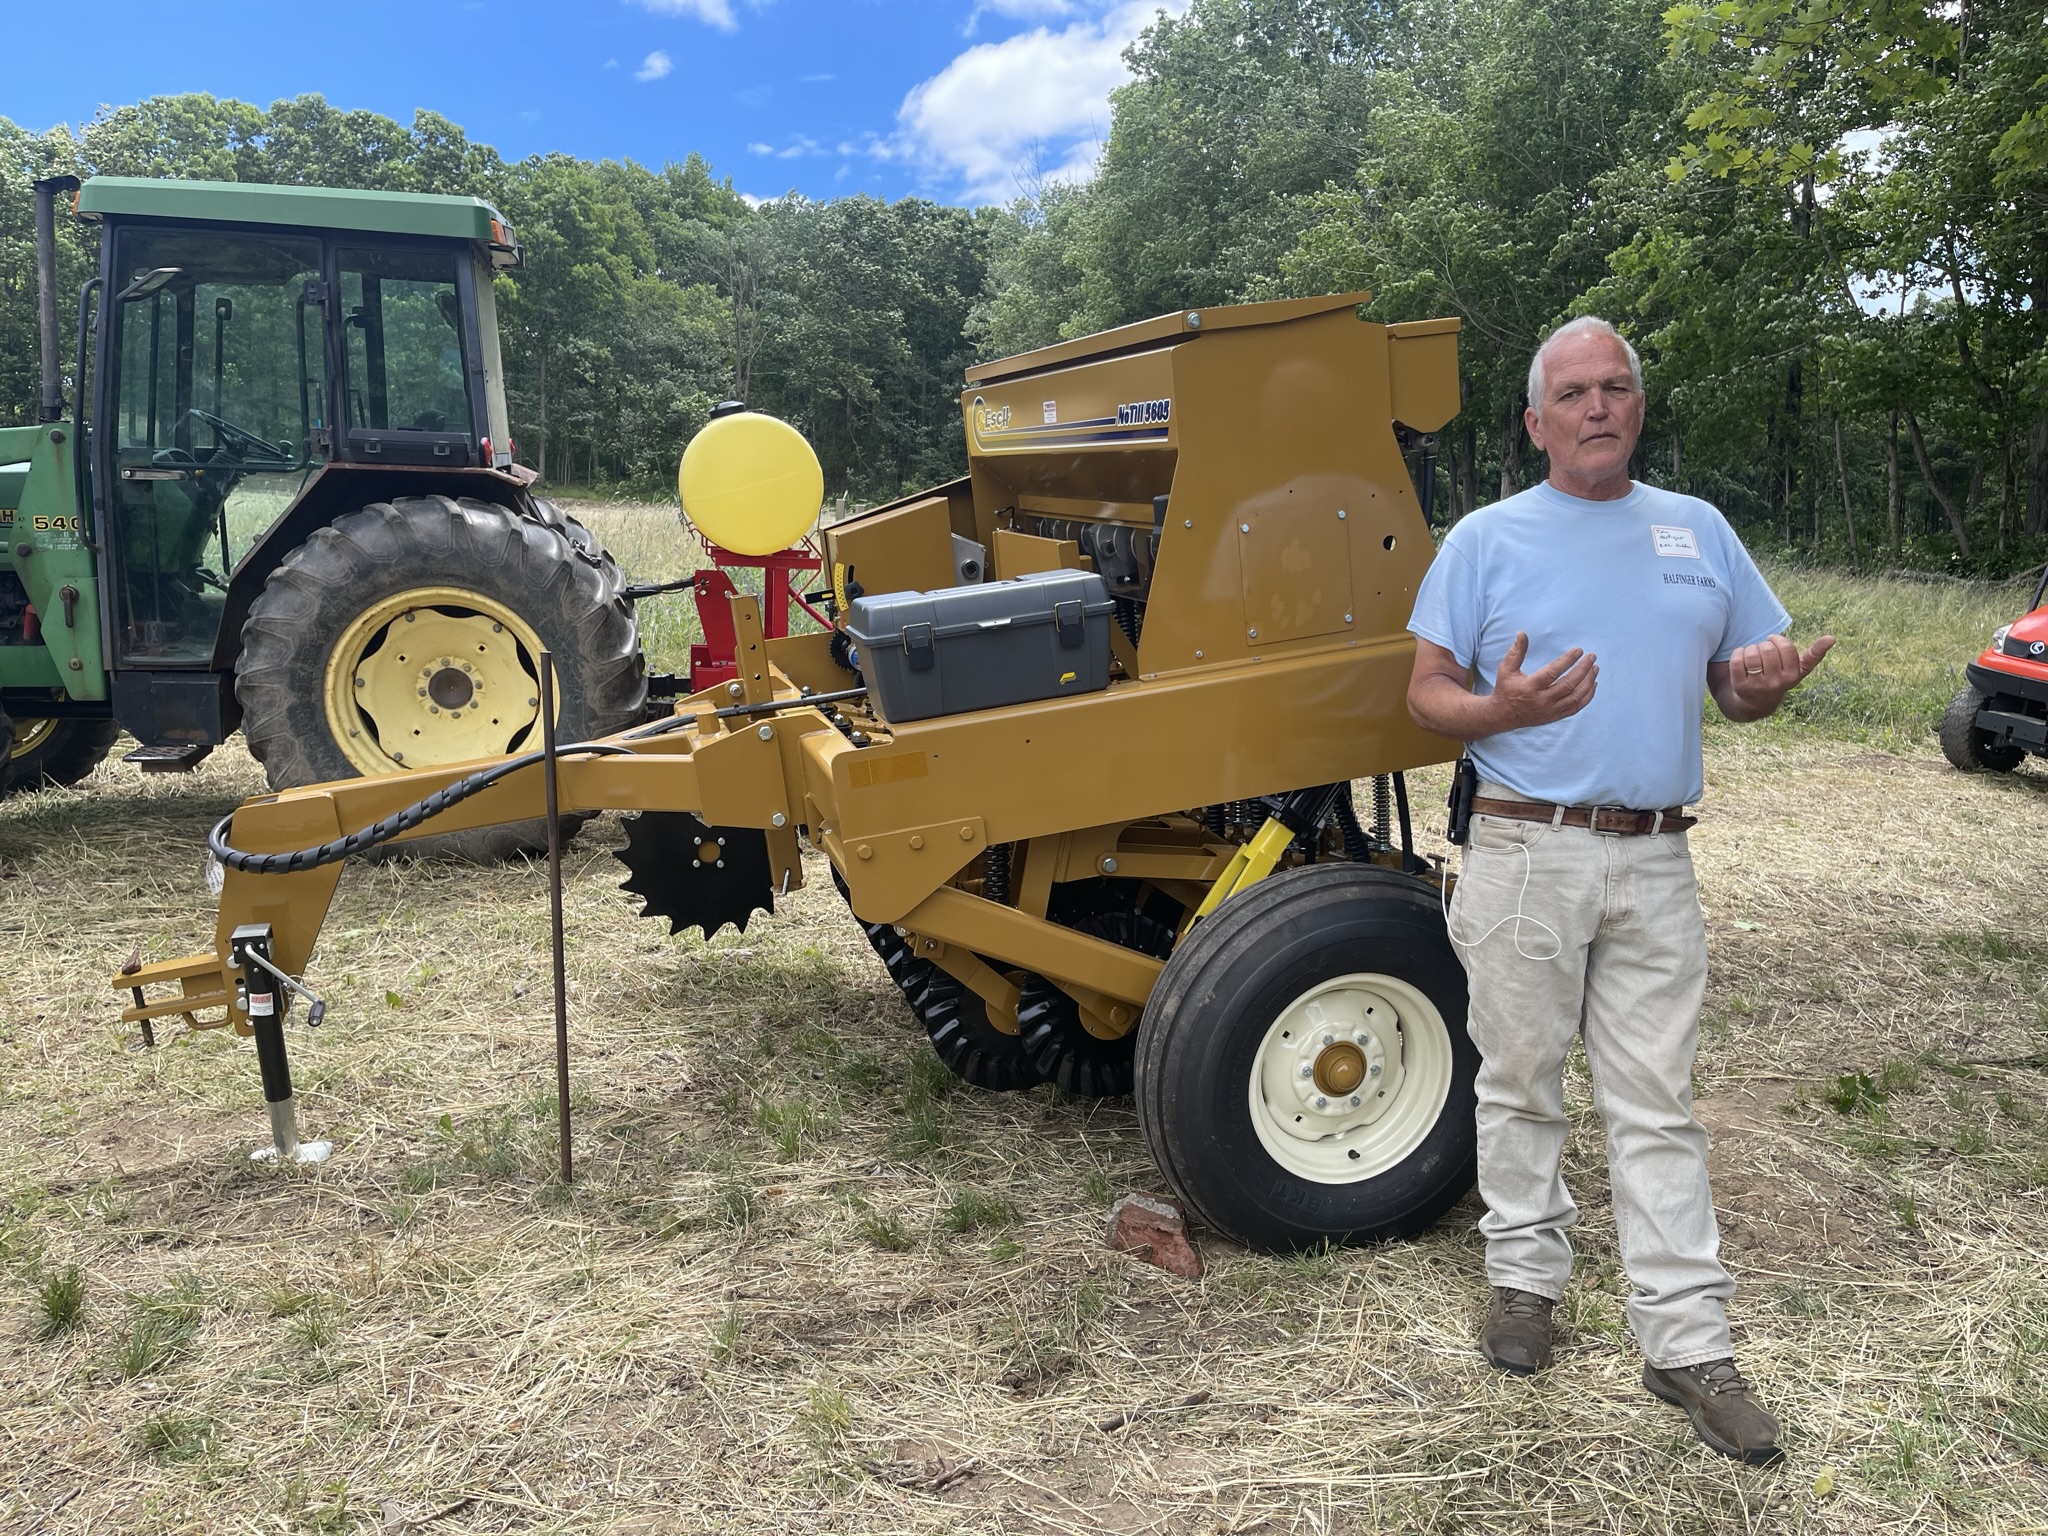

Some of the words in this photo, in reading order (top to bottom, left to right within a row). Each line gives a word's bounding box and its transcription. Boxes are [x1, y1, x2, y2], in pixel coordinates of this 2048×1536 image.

[1144, 398, 1170, 423] 5605
[1663, 573, 1696, 585] HALFINGER
[1696, 576, 1715, 588] FARMS
